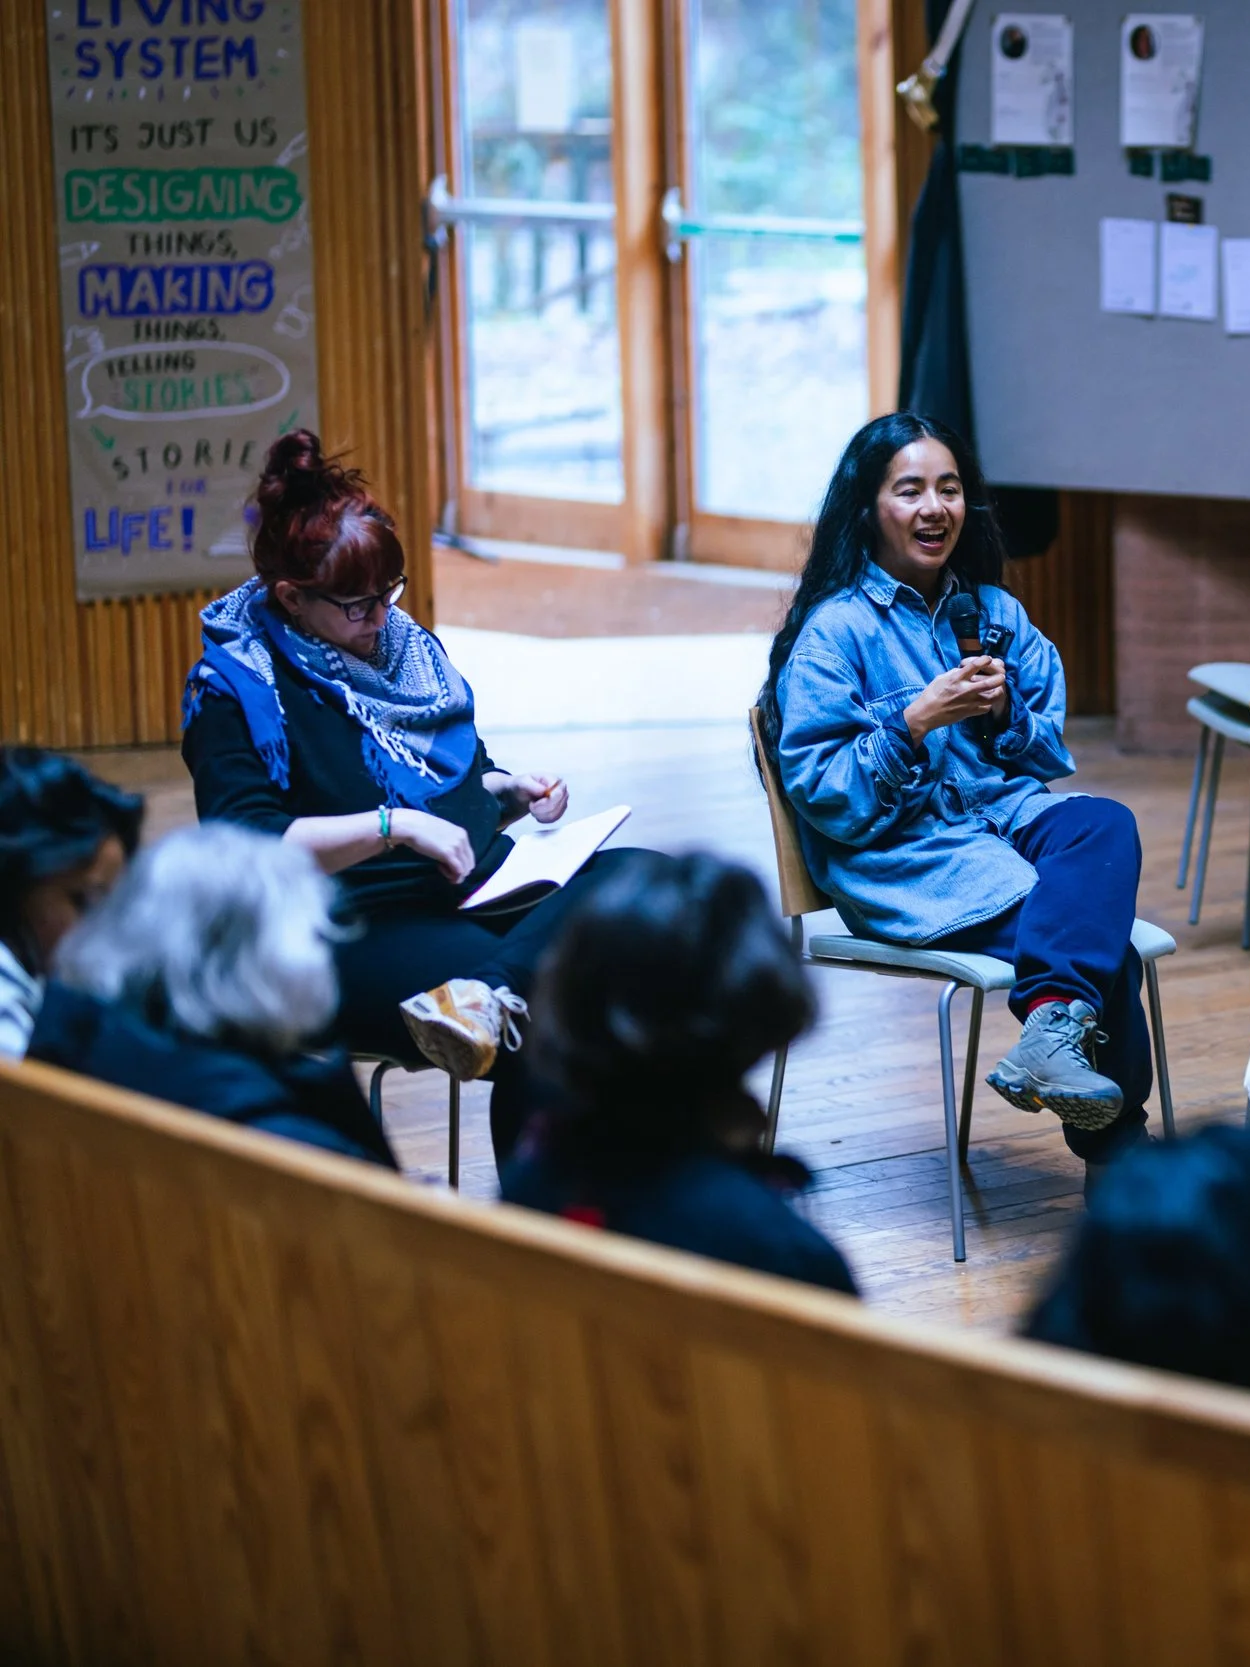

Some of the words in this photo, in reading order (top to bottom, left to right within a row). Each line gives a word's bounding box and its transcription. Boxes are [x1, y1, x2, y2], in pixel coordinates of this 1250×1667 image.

[77, 0, 265, 28] LIVING
[75, 35, 259, 82] SYSTEM
[137, 117, 215, 150] JUST
[233, 116, 278, 148] US
[69, 173, 294, 217] DESIGNING
[82, 265, 269, 312] MAKING
[105, 351, 195, 379] TELLING
[112, 438, 258, 480] STORIE
[84, 505, 195, 555] LIFE!
